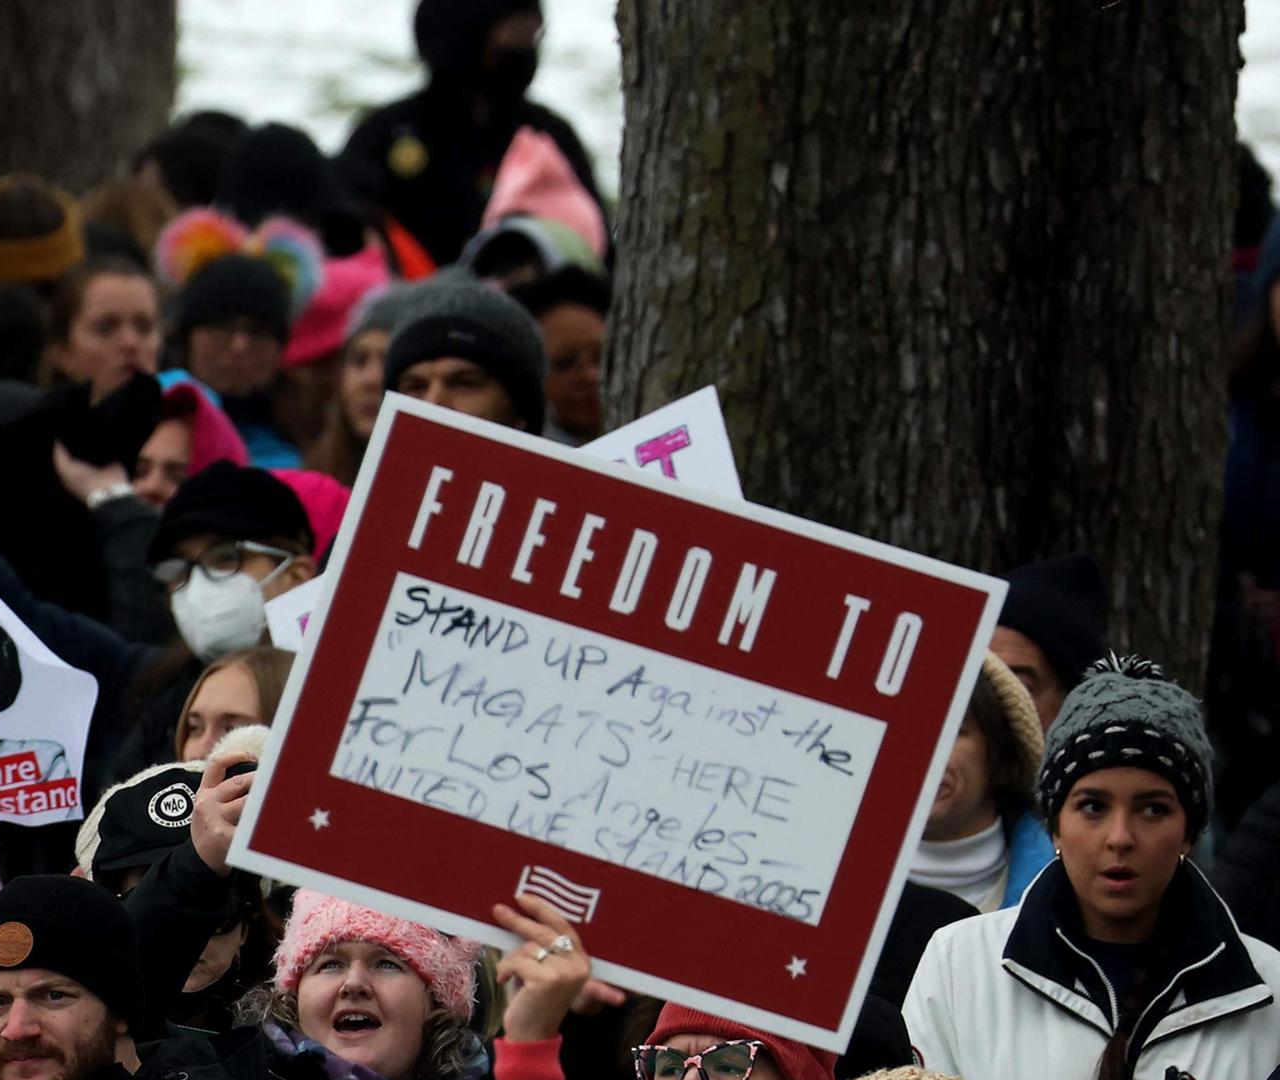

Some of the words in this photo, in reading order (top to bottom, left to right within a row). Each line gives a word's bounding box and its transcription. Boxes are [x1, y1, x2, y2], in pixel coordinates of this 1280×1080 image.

[407, 465, 778, 652] FREEDOM
[826, 593, 924, 697] TO
[544, 637, 608, 681] UP
[781, 719, 854, 776] the
[162, 797, 185, 813] WAC
[339, 750, 488, 820] UNITED
